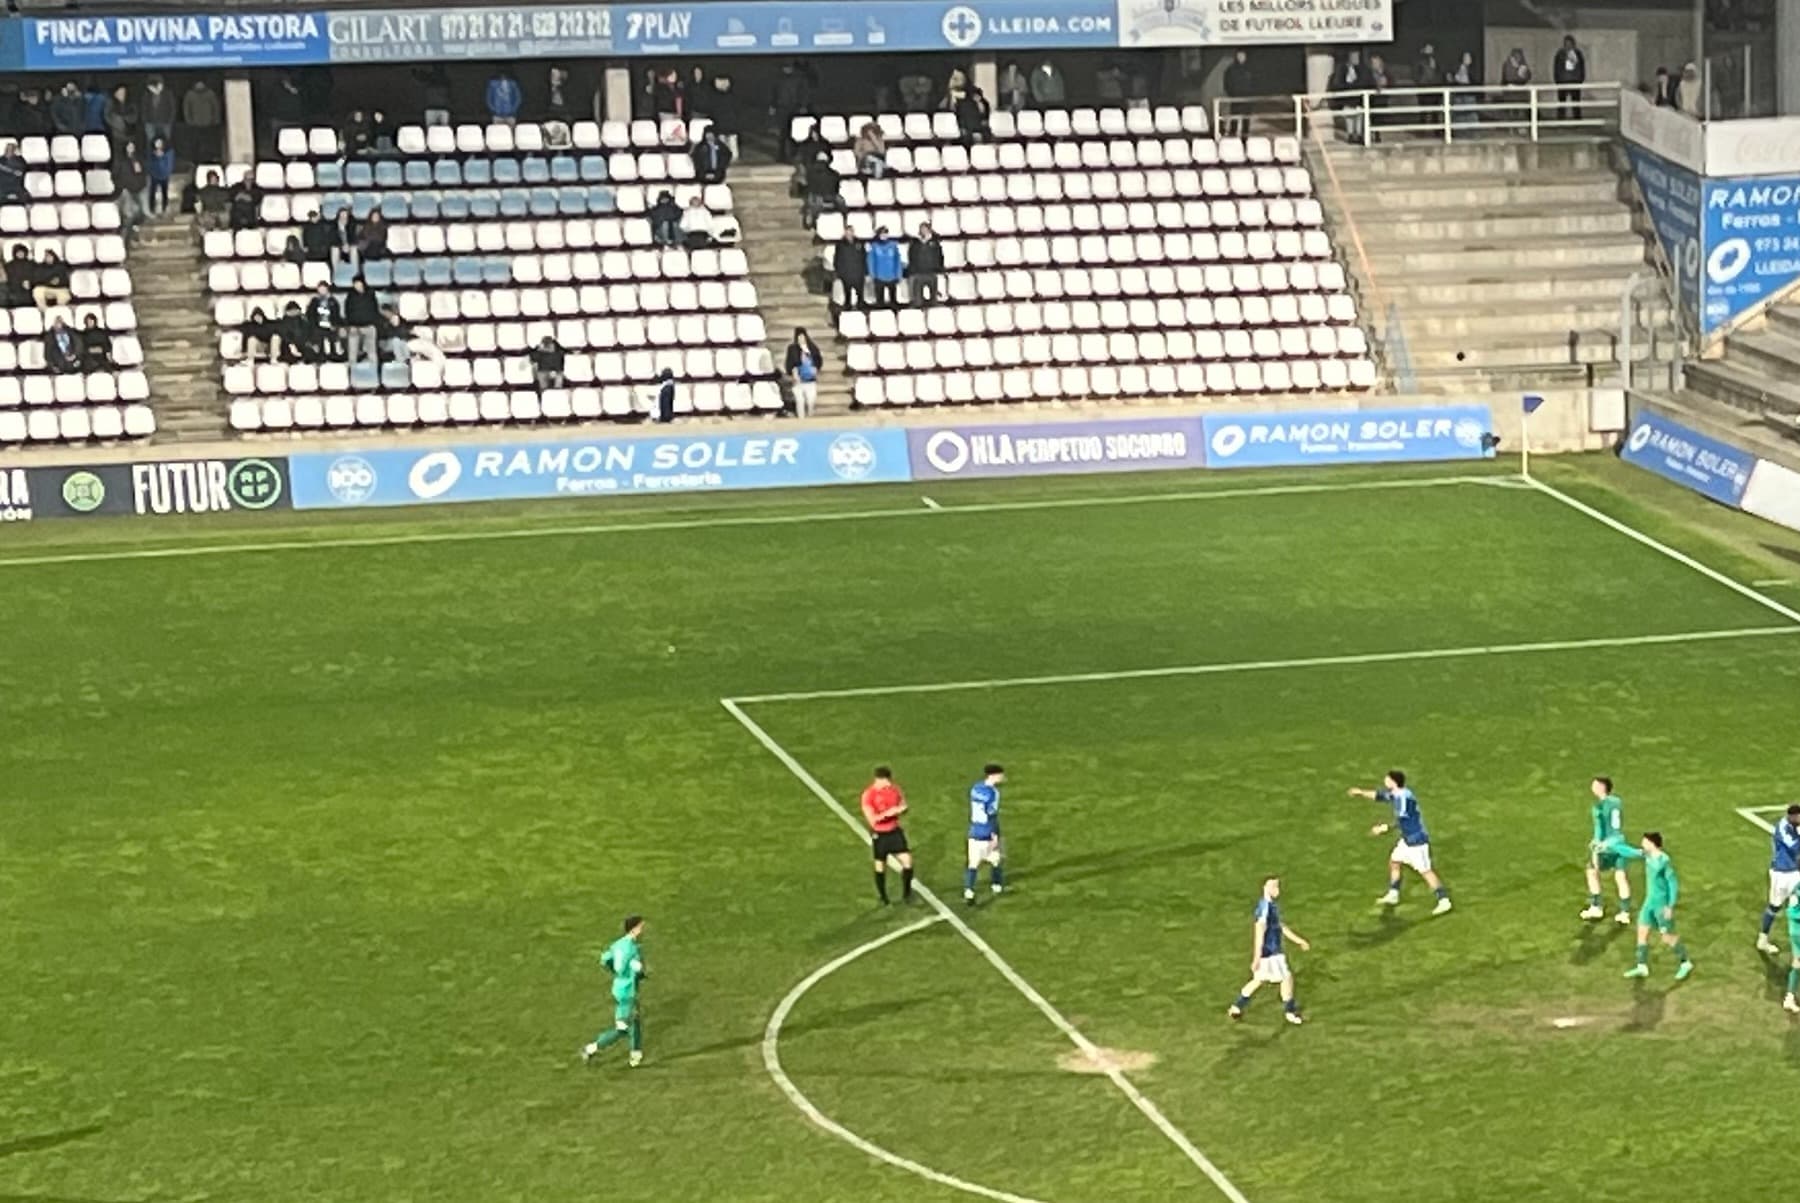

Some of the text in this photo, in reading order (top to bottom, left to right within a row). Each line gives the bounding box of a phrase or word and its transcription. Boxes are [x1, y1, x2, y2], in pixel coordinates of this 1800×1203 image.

[36, 15, 319, 44] FINCA DIVINA PASTORA
[328, 14, 431, 44] GILART
[1251, 418, 1452, 443] RAMON SOLER
[474, 438, 800, 477] RAMON SOLER
[132, 460, 231, 515] FUTUR
